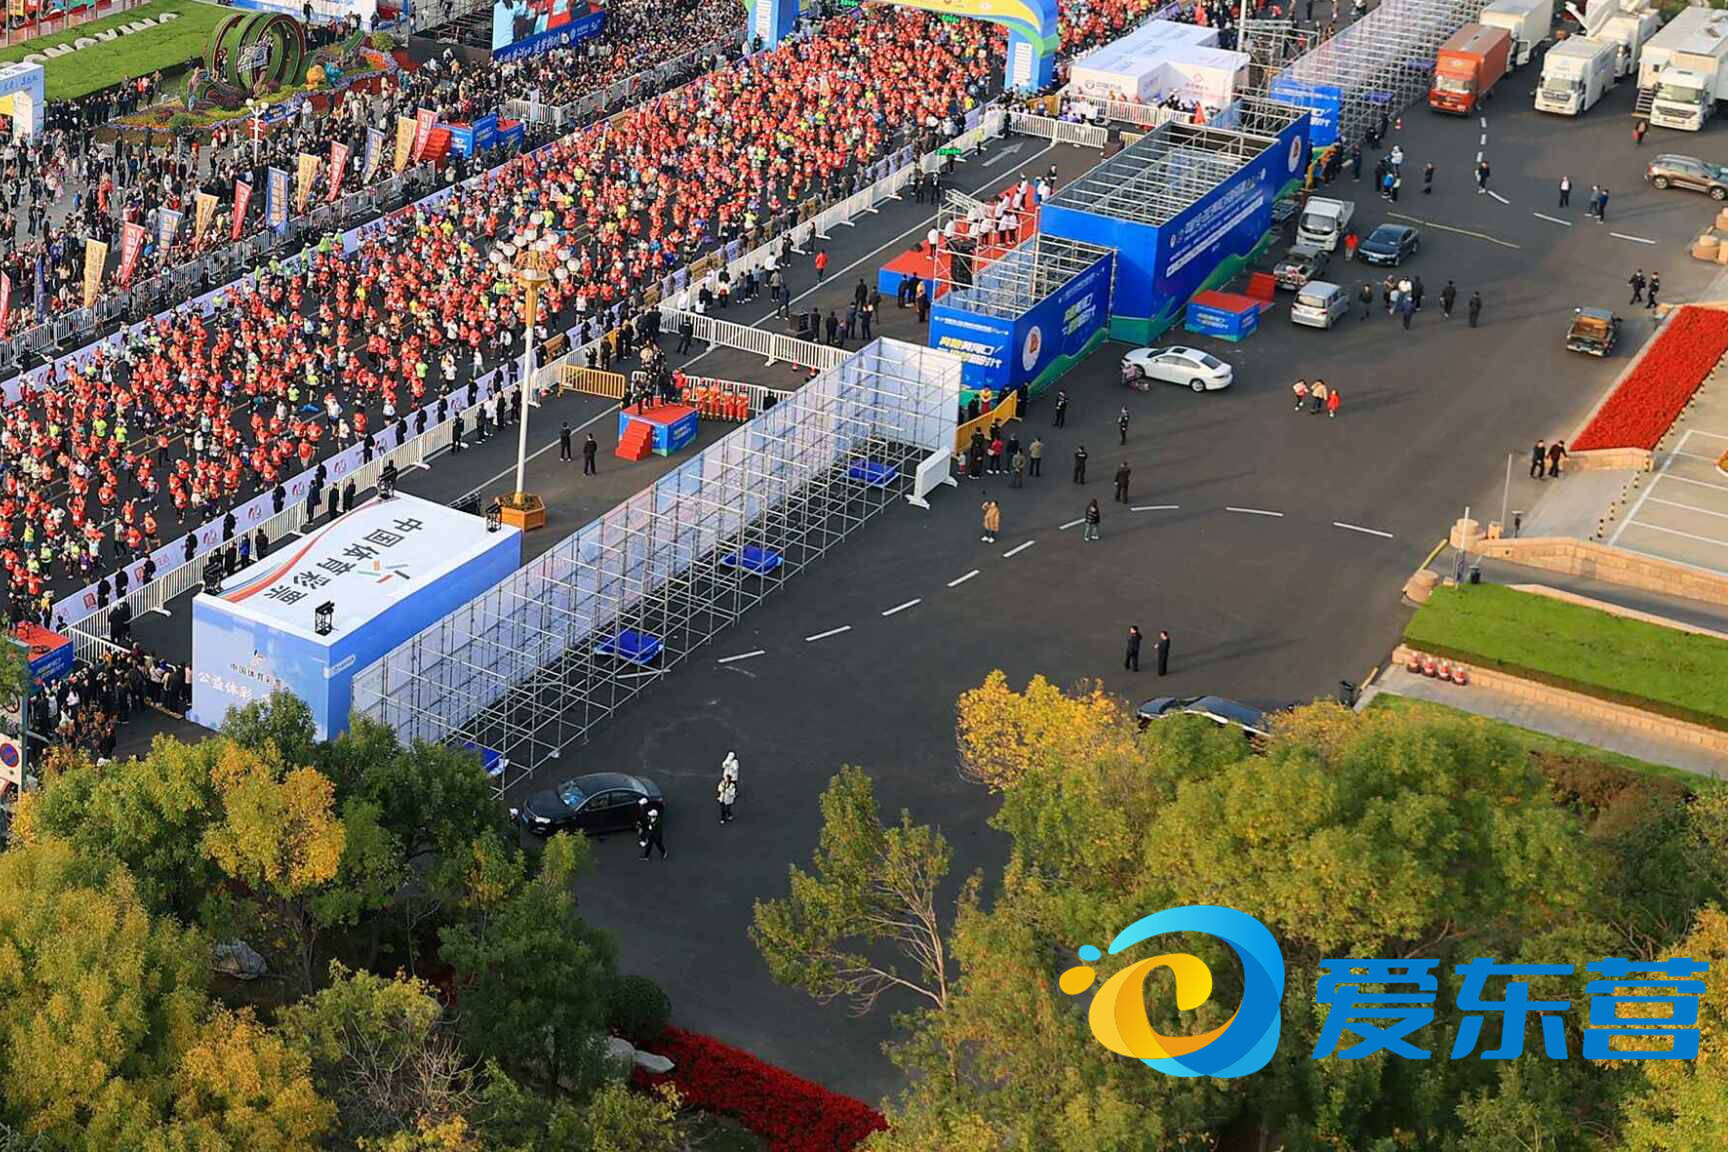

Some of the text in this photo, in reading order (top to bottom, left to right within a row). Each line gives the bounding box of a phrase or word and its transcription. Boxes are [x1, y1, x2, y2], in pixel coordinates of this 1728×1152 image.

[264, 517, 424, 606] 中国体育彩票
